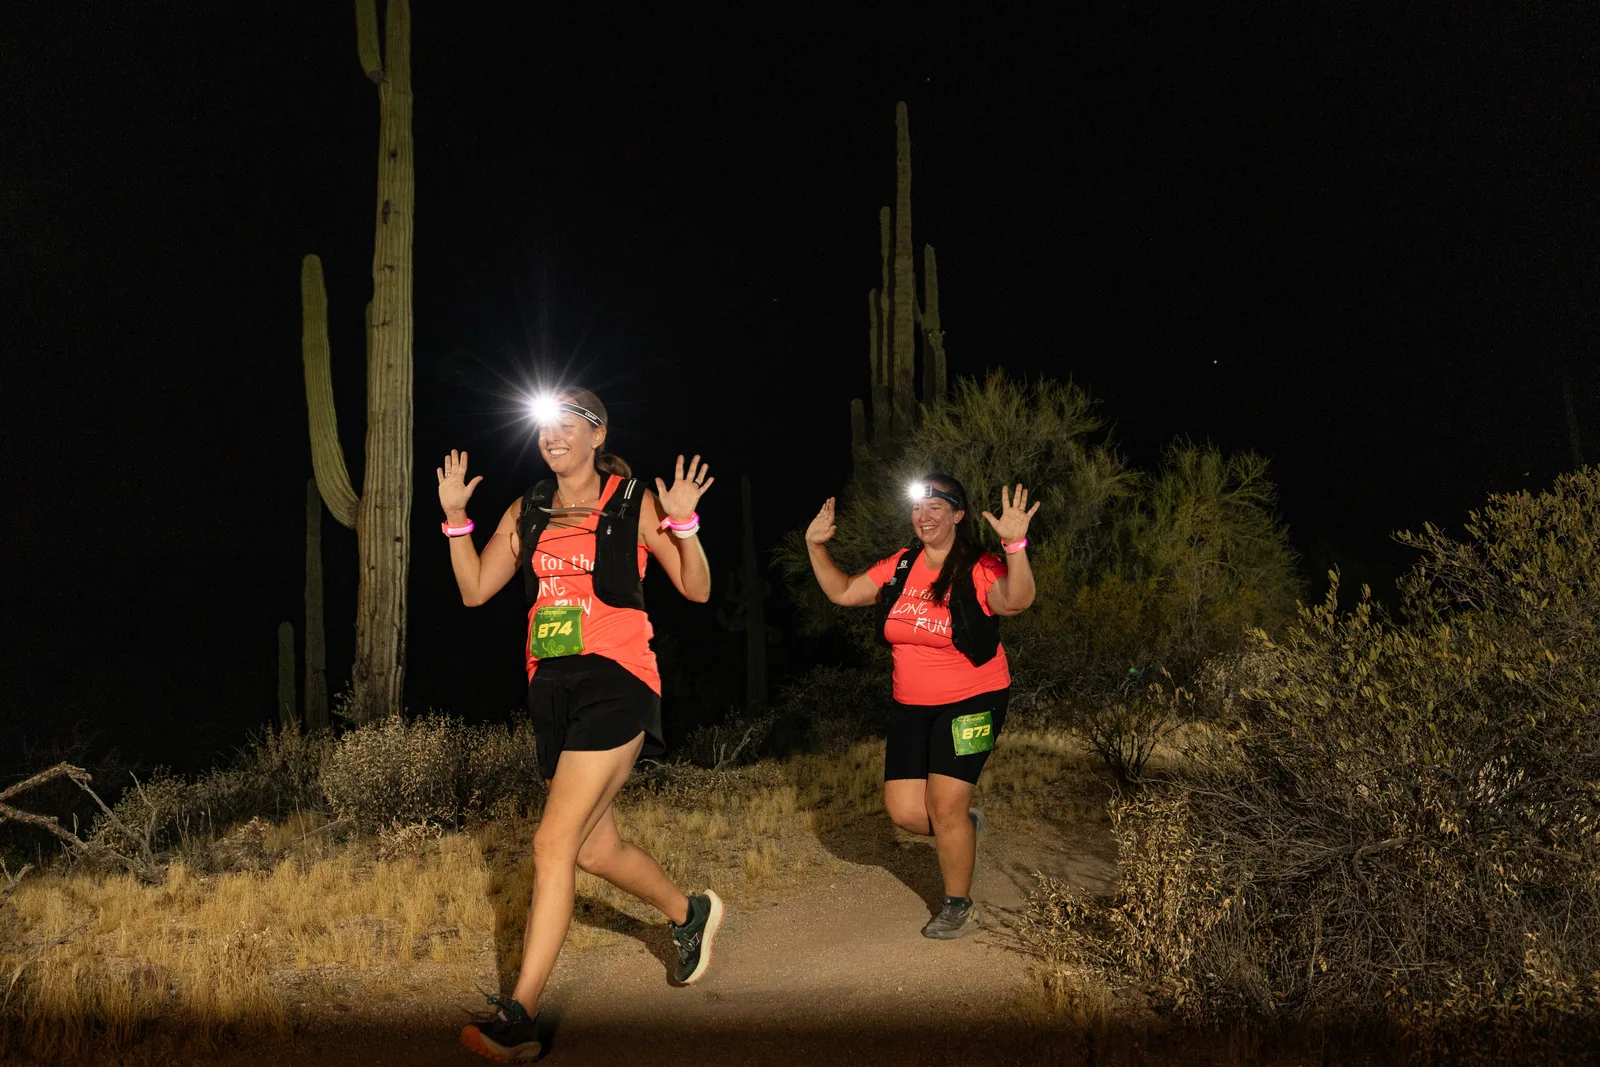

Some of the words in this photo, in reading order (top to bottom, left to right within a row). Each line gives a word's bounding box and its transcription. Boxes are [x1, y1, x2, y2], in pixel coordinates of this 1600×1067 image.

[541, 554, 566, 570] for
[537, 574, 566, 599] NG
[908, 586, 917, 598] it
[892, 601, 928, 615] LONG
[537, 621, 573, 639] 874
[914, 617, 950, 634] RUN
[962, 724, 991, 740] 873
